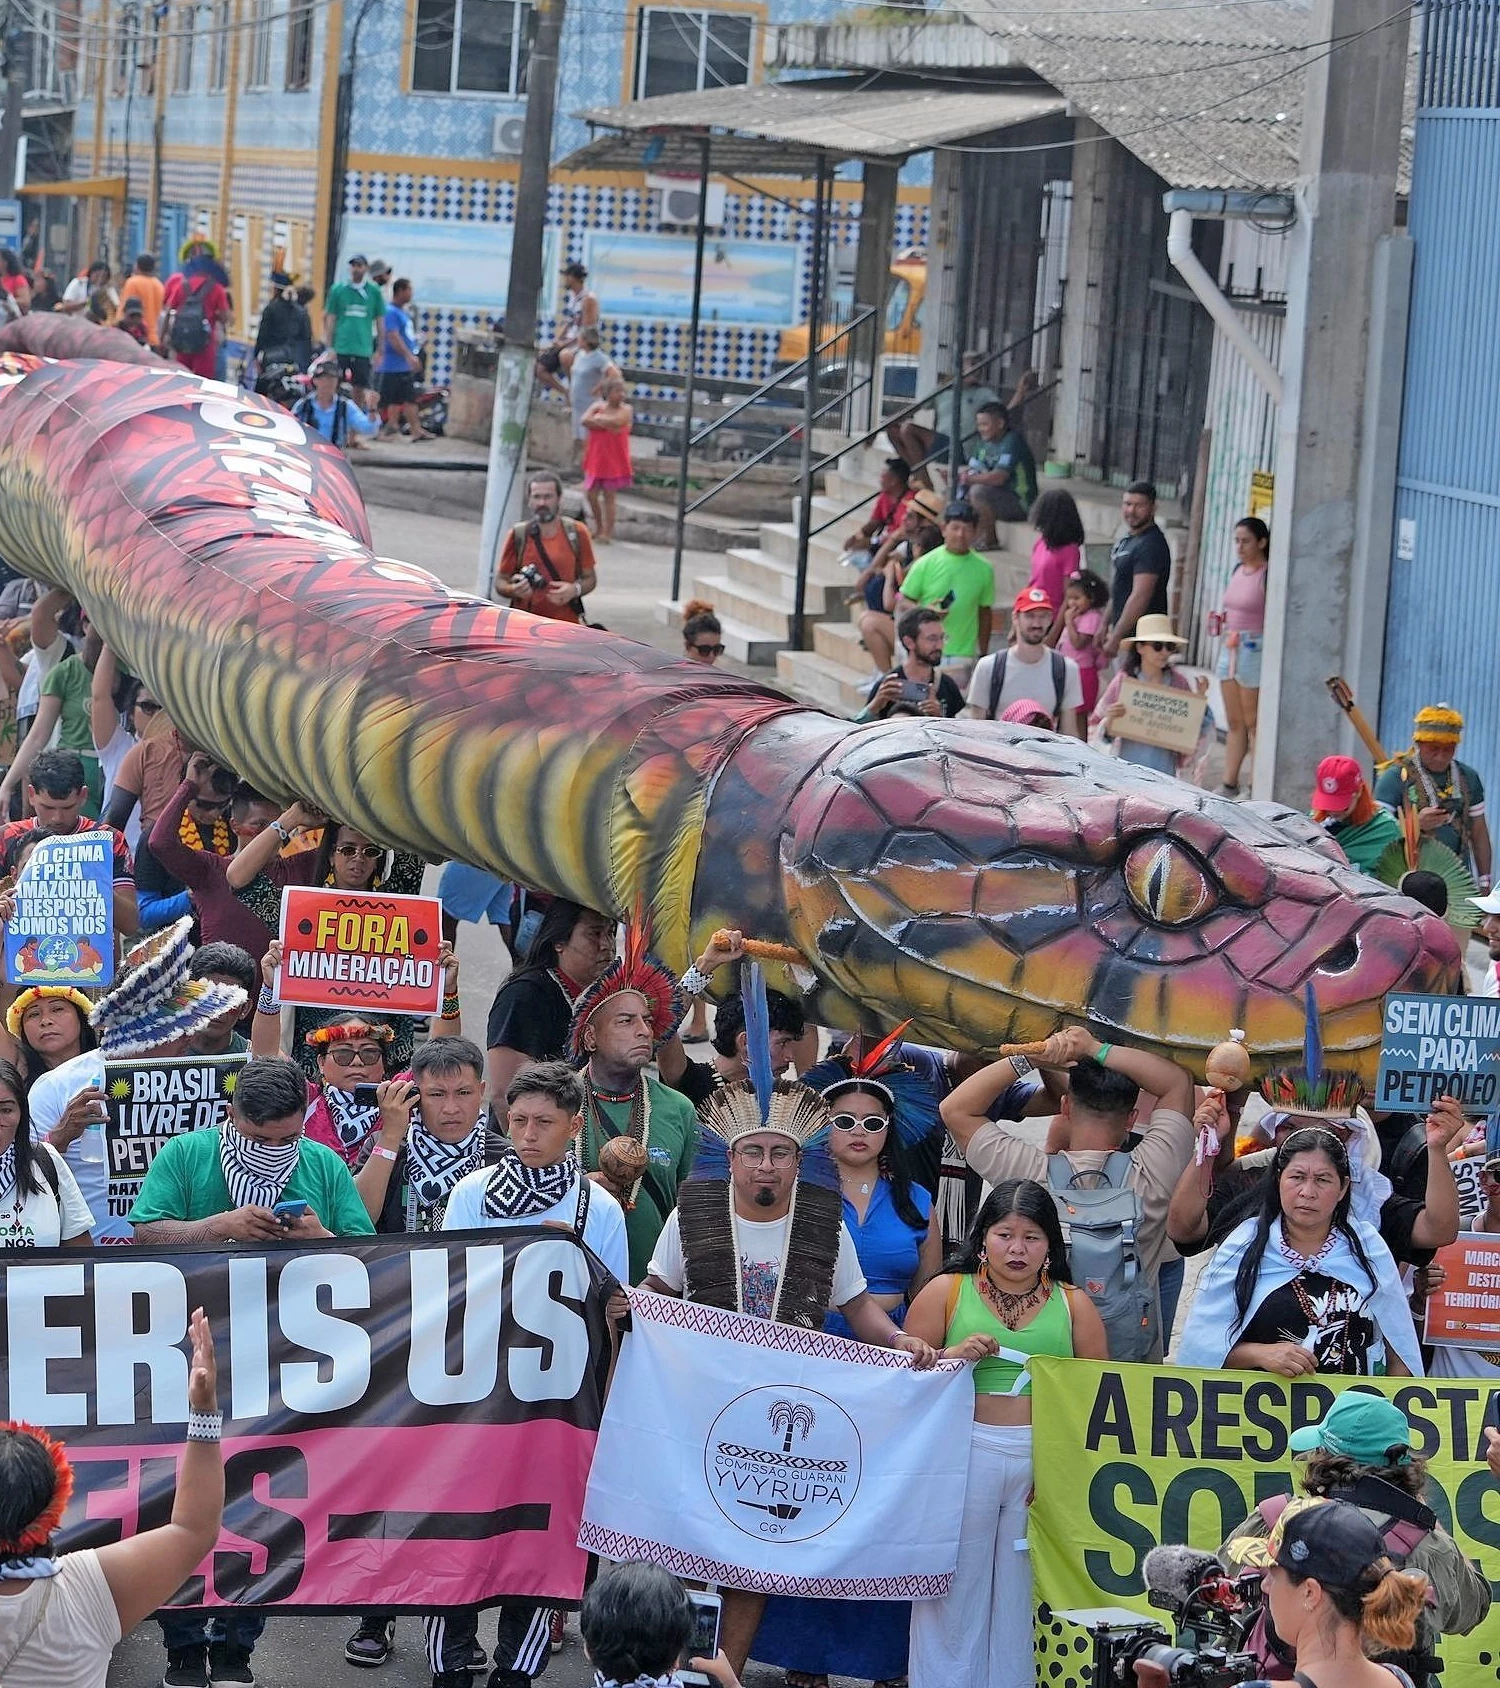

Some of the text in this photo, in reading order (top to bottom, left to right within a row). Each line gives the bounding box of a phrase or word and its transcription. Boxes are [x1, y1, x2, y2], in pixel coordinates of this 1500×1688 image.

[44, 862, 83, 880] PELA
[52, 845, 104, 863] CLIMA
[9, 914, 106, 935] SOMOS NÓS
[23, 899, 107, 918] RESPOSTA
[316, 910, 411, 955] FORA
[288, 950, 434, 989] MINERAÇÃO
[1385, 1000, 1441, 1035] SEM
[1418, 1037, 1478, 1072] PARA
[132, 1068, 220, 1102] BRASIL
[1383, 1067, 1496, 1105] PETRÓLEO
[119, 1100, 228, 1137] LIVRE DE
[229, 1254, 372, 1420] IS
[408, 1240, 589, 1406] US
[1085, 1372, 1137, 1456] A
[715, 1455, 846, 1484] COMISSÃO GUARANI
[715, 1466, 843, 1506] YVYRUPA
[759, 1521, 787, 1534] CGY
